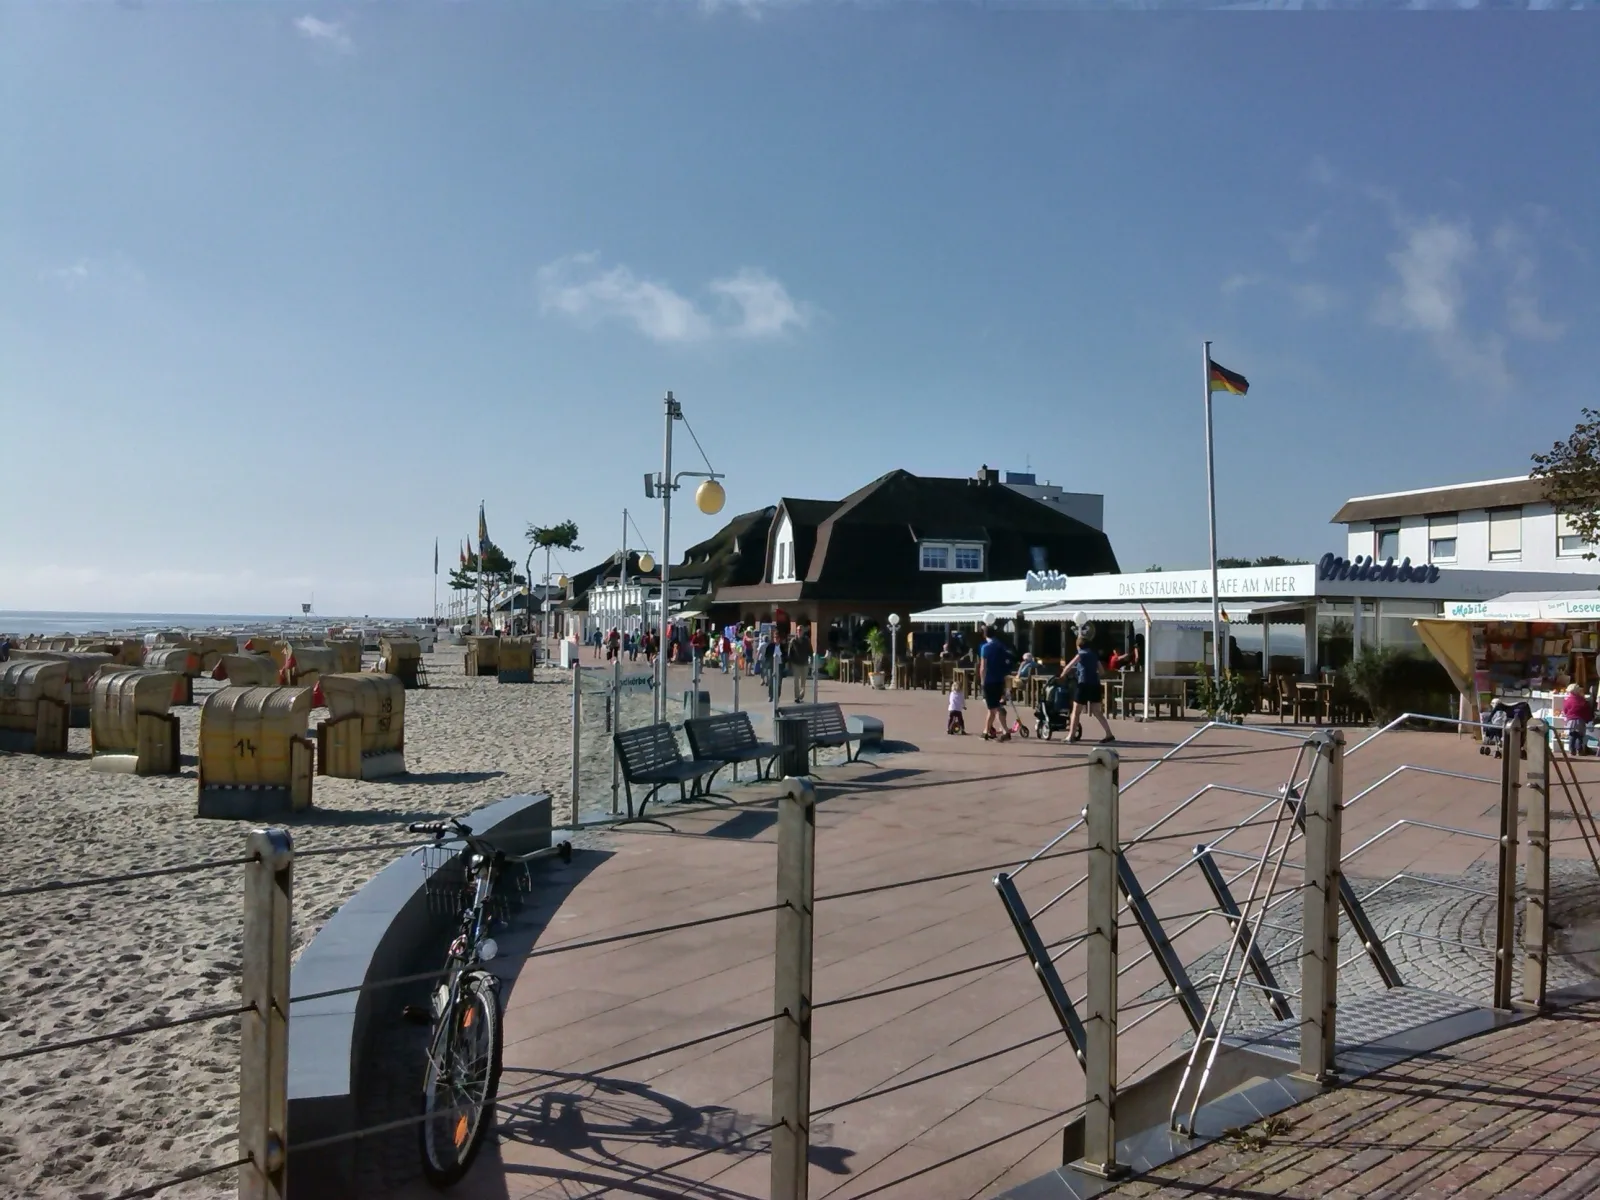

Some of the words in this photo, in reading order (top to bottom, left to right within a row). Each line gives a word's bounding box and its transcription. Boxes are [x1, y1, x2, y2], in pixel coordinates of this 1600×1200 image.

[1319, 552, 1440, 584] Milchbar
[1119, 582, 1136, 596] DAS
[1140, 580, 1198, 595] RESTAURANT
[1201, 579, 1209, 594] &
[1217, 579, 1238, 593] AFE
[1242, 577, 1260, 592] AM
[1264, 576, 1296, 592] MEER
[235, 738, 256, 758] 14
